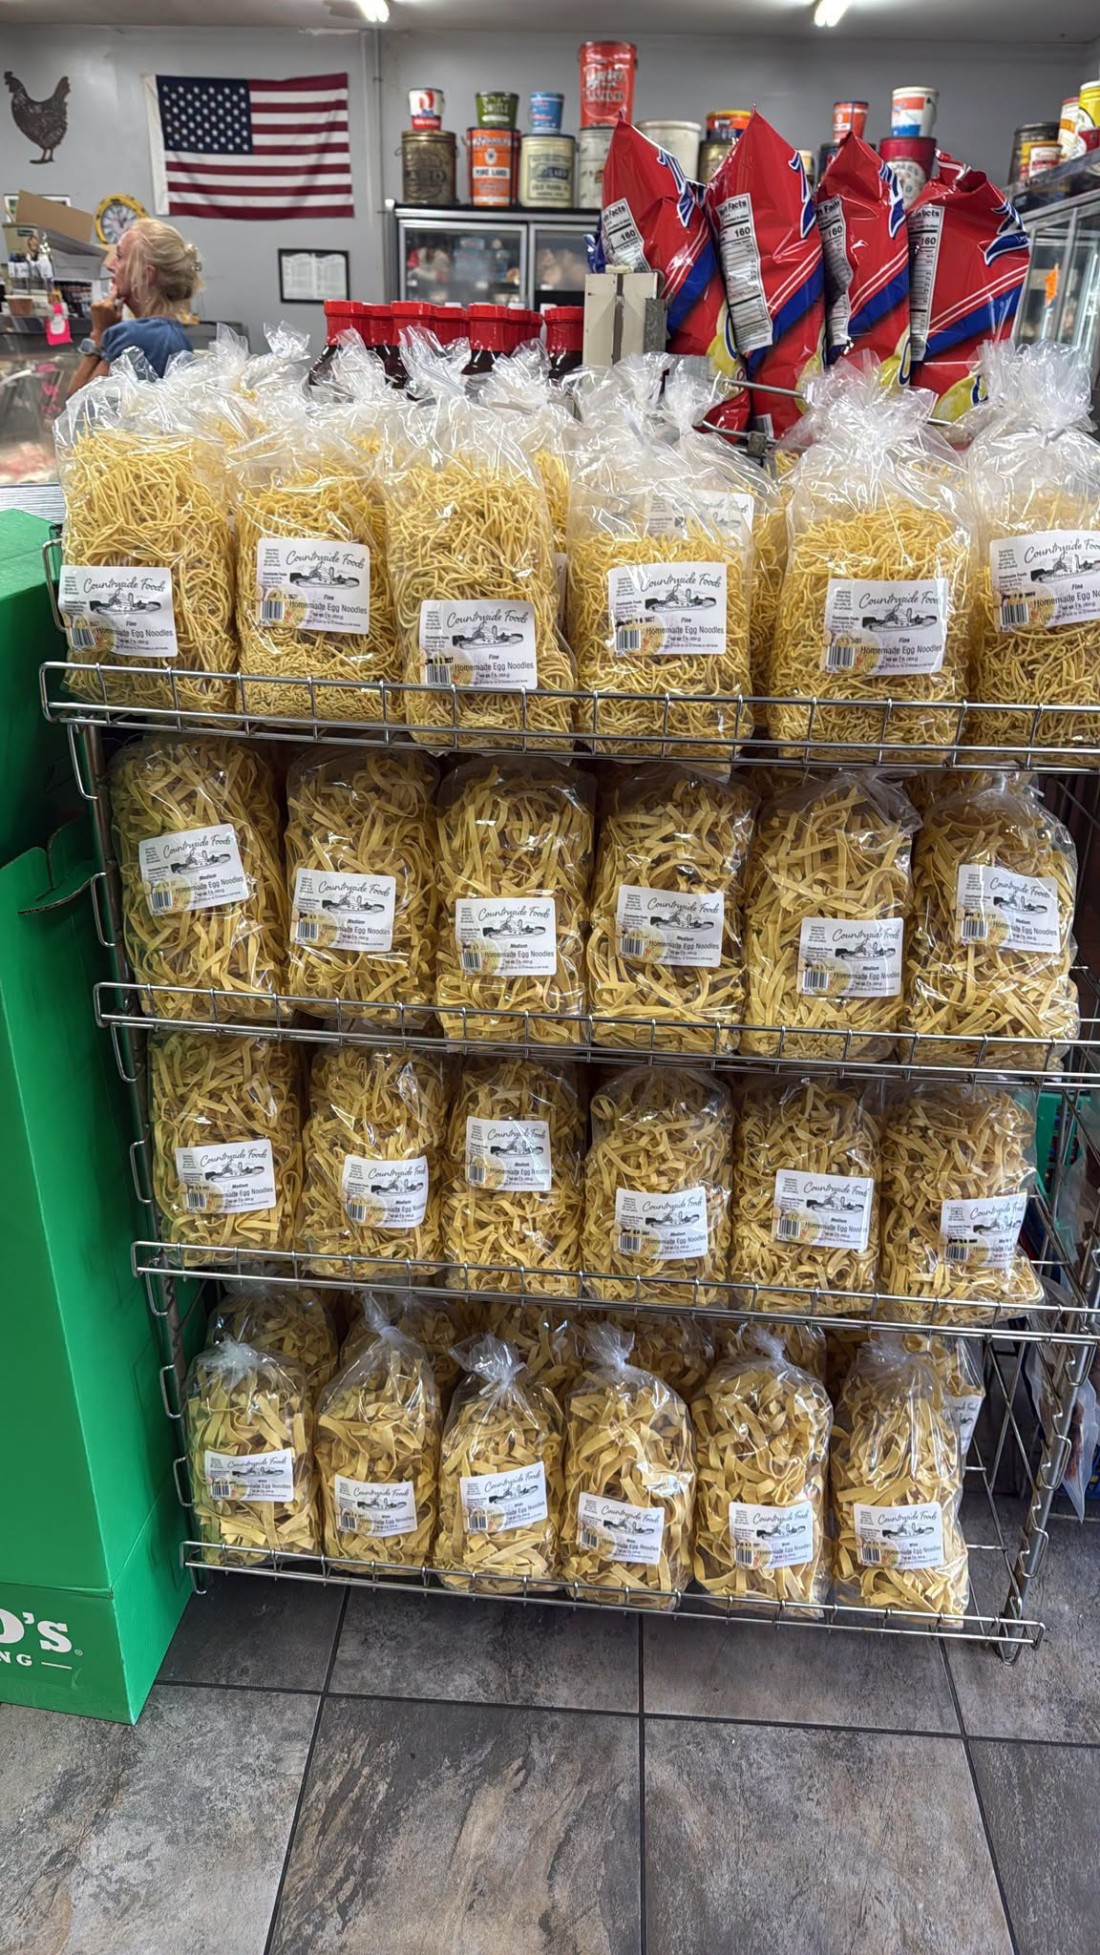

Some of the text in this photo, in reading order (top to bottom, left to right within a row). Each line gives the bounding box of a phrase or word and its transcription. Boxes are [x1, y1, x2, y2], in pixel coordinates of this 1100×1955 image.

[728, 200, 747, 211] Facts
[620, 230, 636, 241] 160
[735, 226, 751, 238] 160
[828, 226, 843, 238] 160
[920, 237, 936, 245] 160
[1024, 538, 1100, 563] Countryside Foo
[286, 551, 365, 569] Countryside Foods
[84, 577, 165, 593] Countryside Foods
[699, 573, 721, 588] Foods
[859, 591, 918, 608] Countryside
[1033, 593, 1075, 607] Homemade
[1077, 592, 1090, 601] Egg
[290, 601, 367, 614] Homemade Egg Noodles
[447, 609, 528, 628] Countryside Foods
[97, 628, 129, 637] Homemade
[132, 630, 143, 638] Egg
[647, 626, 723, 635] Homemade Egg Noodles
[861, 646, 900, 654] Homemade
[902, 646, 915, 654] Egg
[455, 662, 533, 672] Homemade Egg Noodles
[163, 835, 231, 858] Countryside Foods
[208, 880, 219, 888] Egg
[221, 876, 243, 885] Noodles
[319, 881, 391, 896] Countryside Foods
[990, 877, 1028, 893] Countryside
[647, 898, 719, 913] Countryside Foods
[478, 906, 550, 921] Countryside Foods
[1022, 927, 1032, 935] Egg
[1034, 928, 1057, 936] Noodles
[531, 1128, 545, 1139] Foods
[200, 1149, 267, 1167] Countryside Foods
[368, 1166, 412, 1179] Countryside
[803, 1182, 850, 1194] Countryside
[642, 1197, 702, 1212] Countryside Foods
[228, 1458, 267, 1468] Countryside
[485, 1474, 523, 1492] Countryside
[354, 1487, 391, 1497] Countryside
[601, 1505, 641, 1520] Countryside
[753, 1512, 792, 1524] Countryside
[878, 1511, 918, 1524] Countryside
